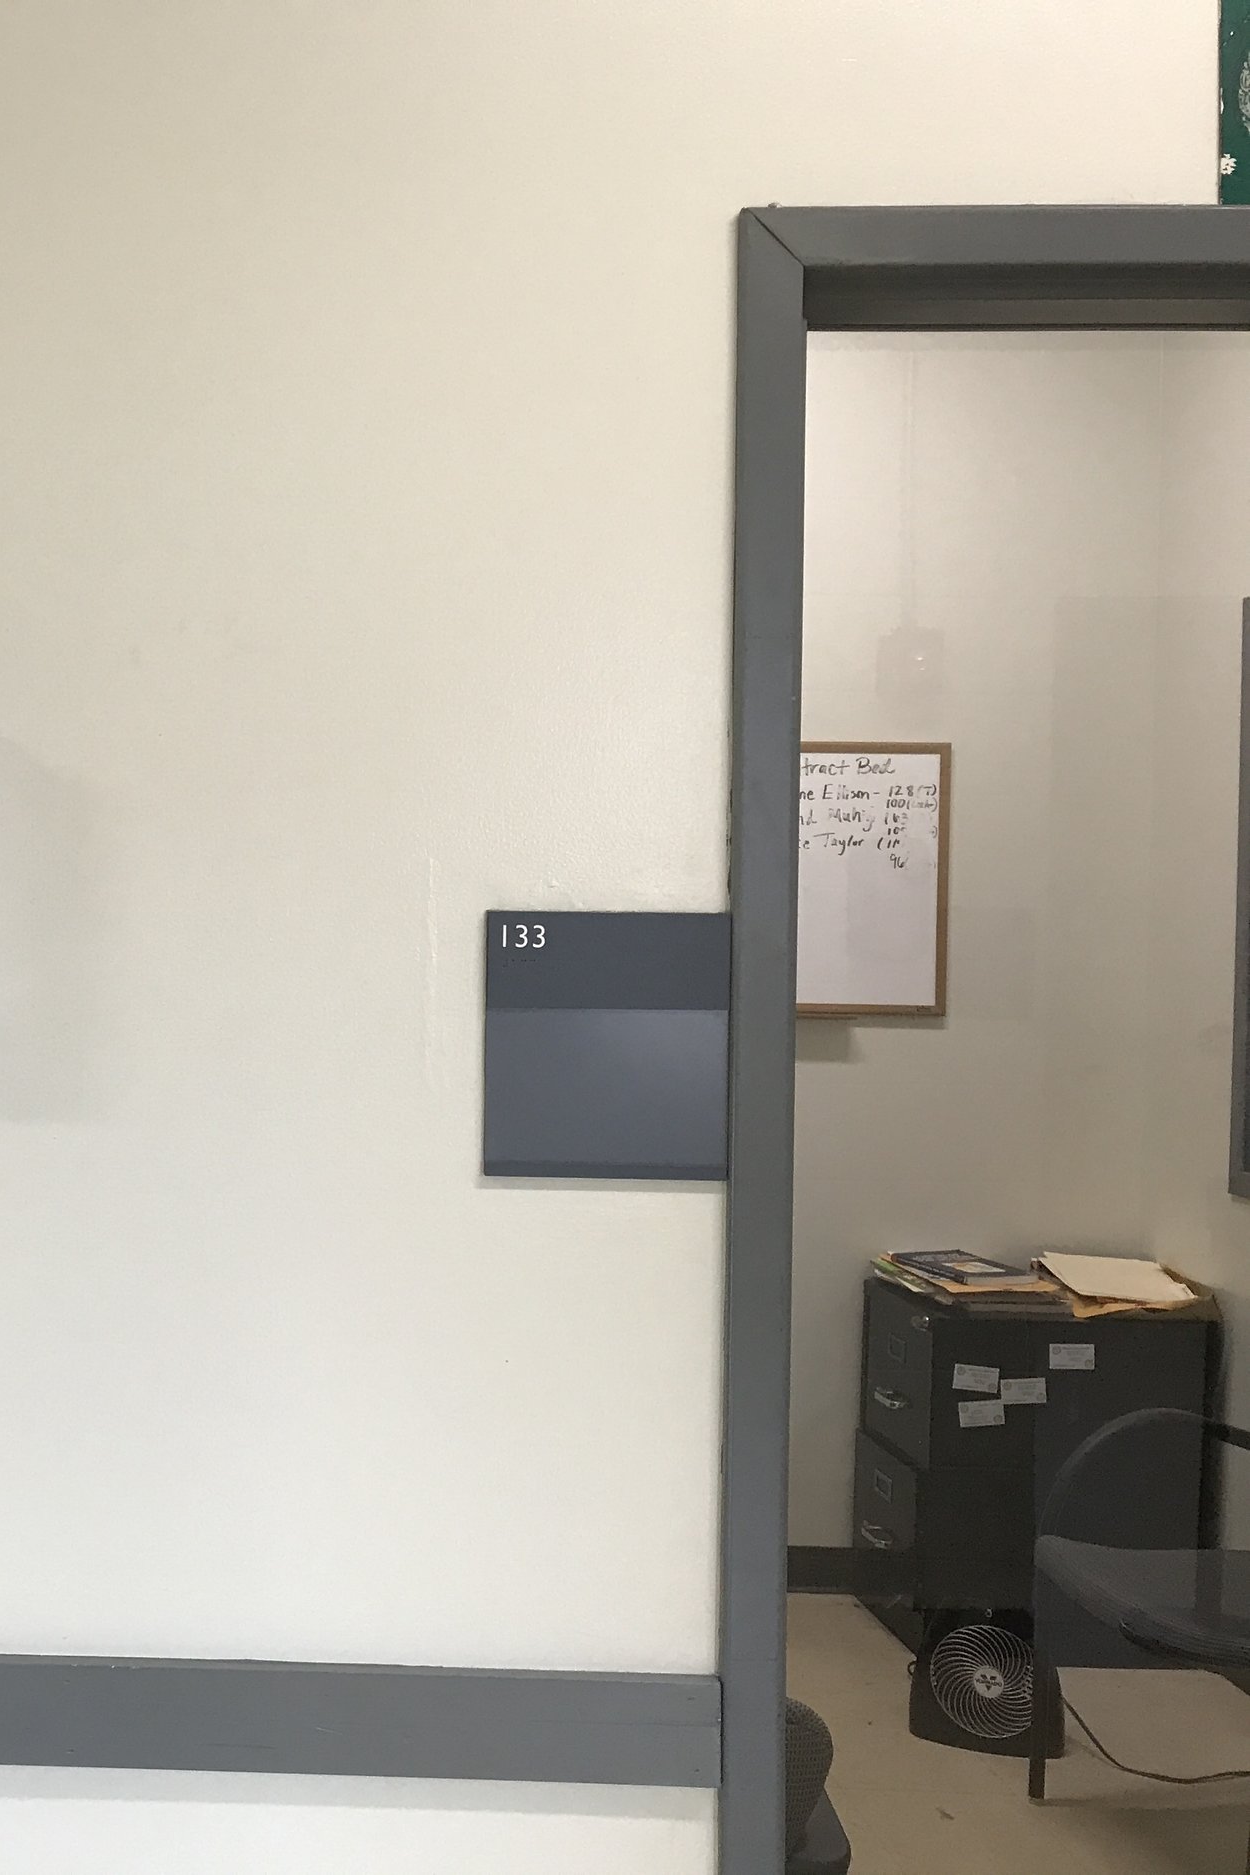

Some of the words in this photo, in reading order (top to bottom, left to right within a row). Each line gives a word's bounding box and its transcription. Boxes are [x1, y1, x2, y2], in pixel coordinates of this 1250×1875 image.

[856, 756, 897, 776] Bed
[813, 832, 865, 856] Taylor
[502, 925, 547, 948] 133
